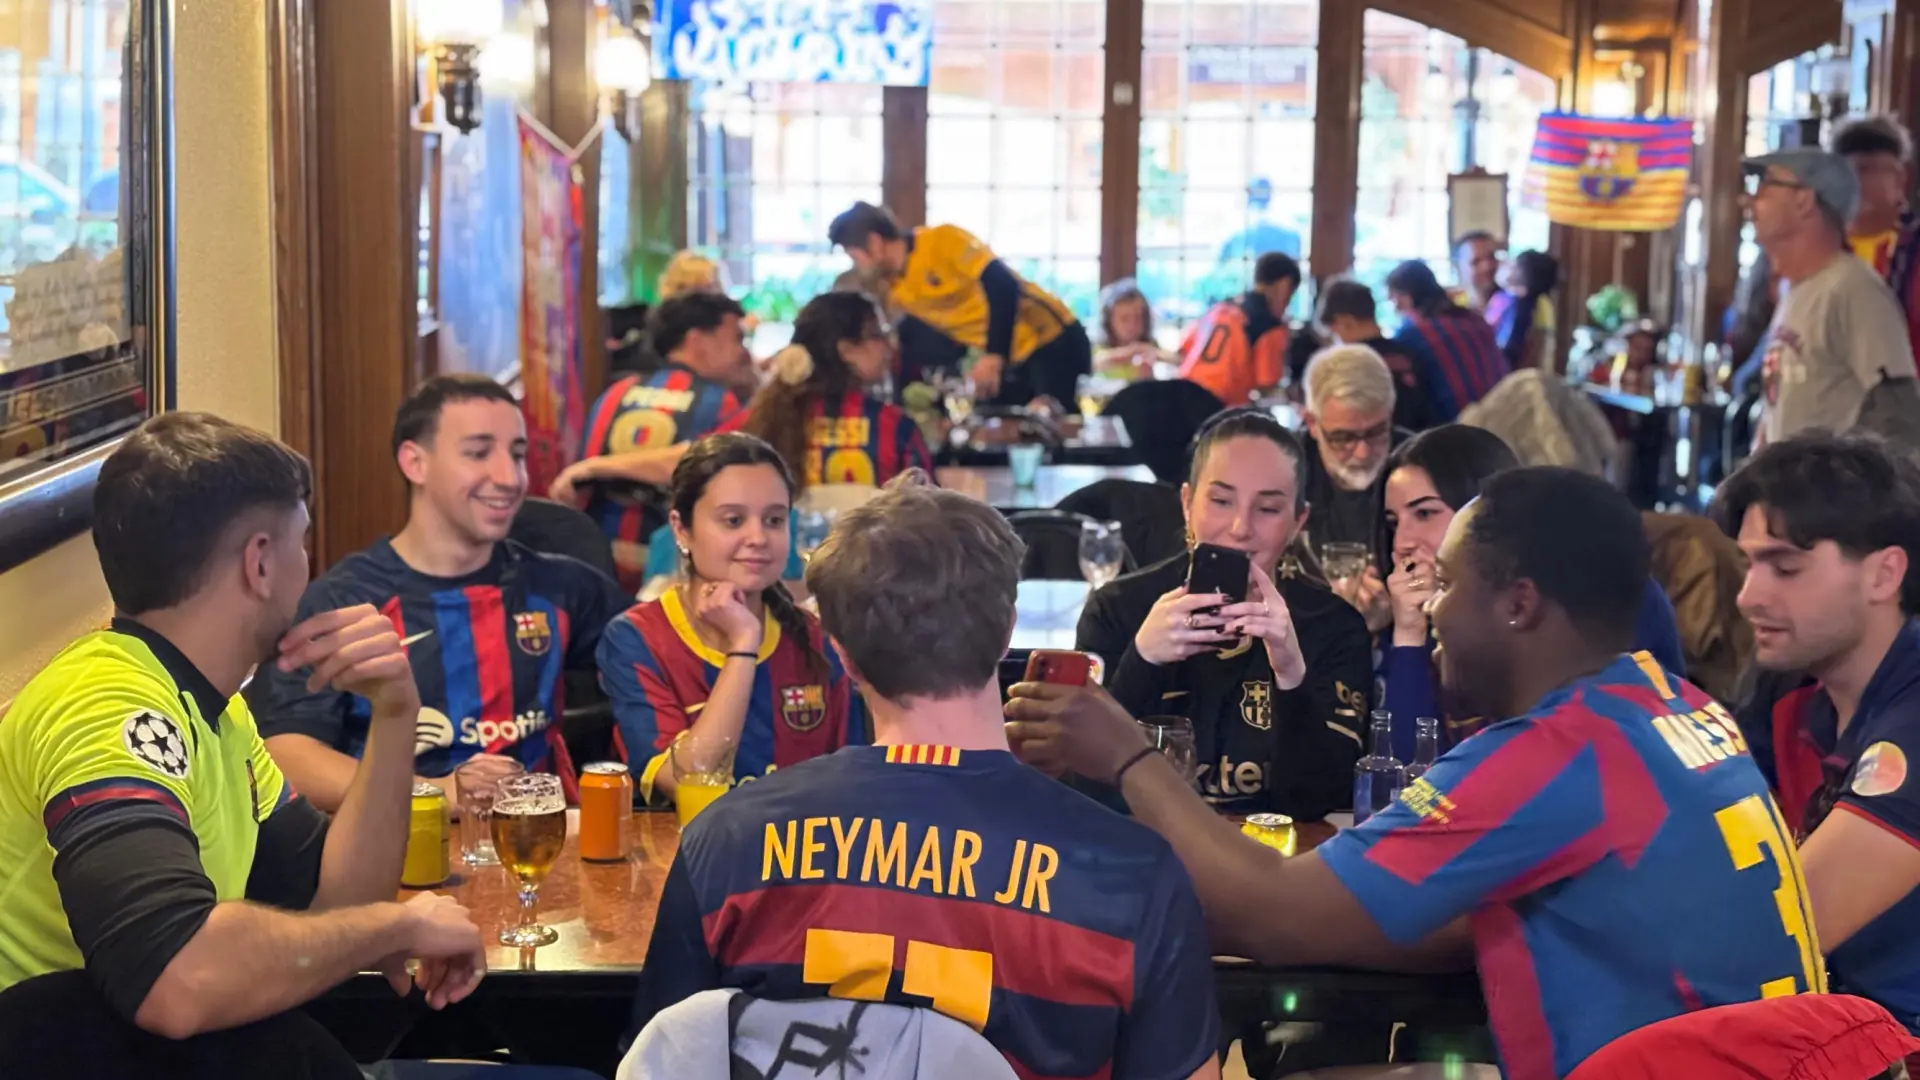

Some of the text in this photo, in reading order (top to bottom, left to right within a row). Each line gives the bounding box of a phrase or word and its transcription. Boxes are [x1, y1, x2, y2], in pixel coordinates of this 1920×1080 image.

[459, 710, 550, 748] Spotif
[1651, 701, 1748, 770] MESS
[761, 816, 1059, 913] NEYMAR JR
